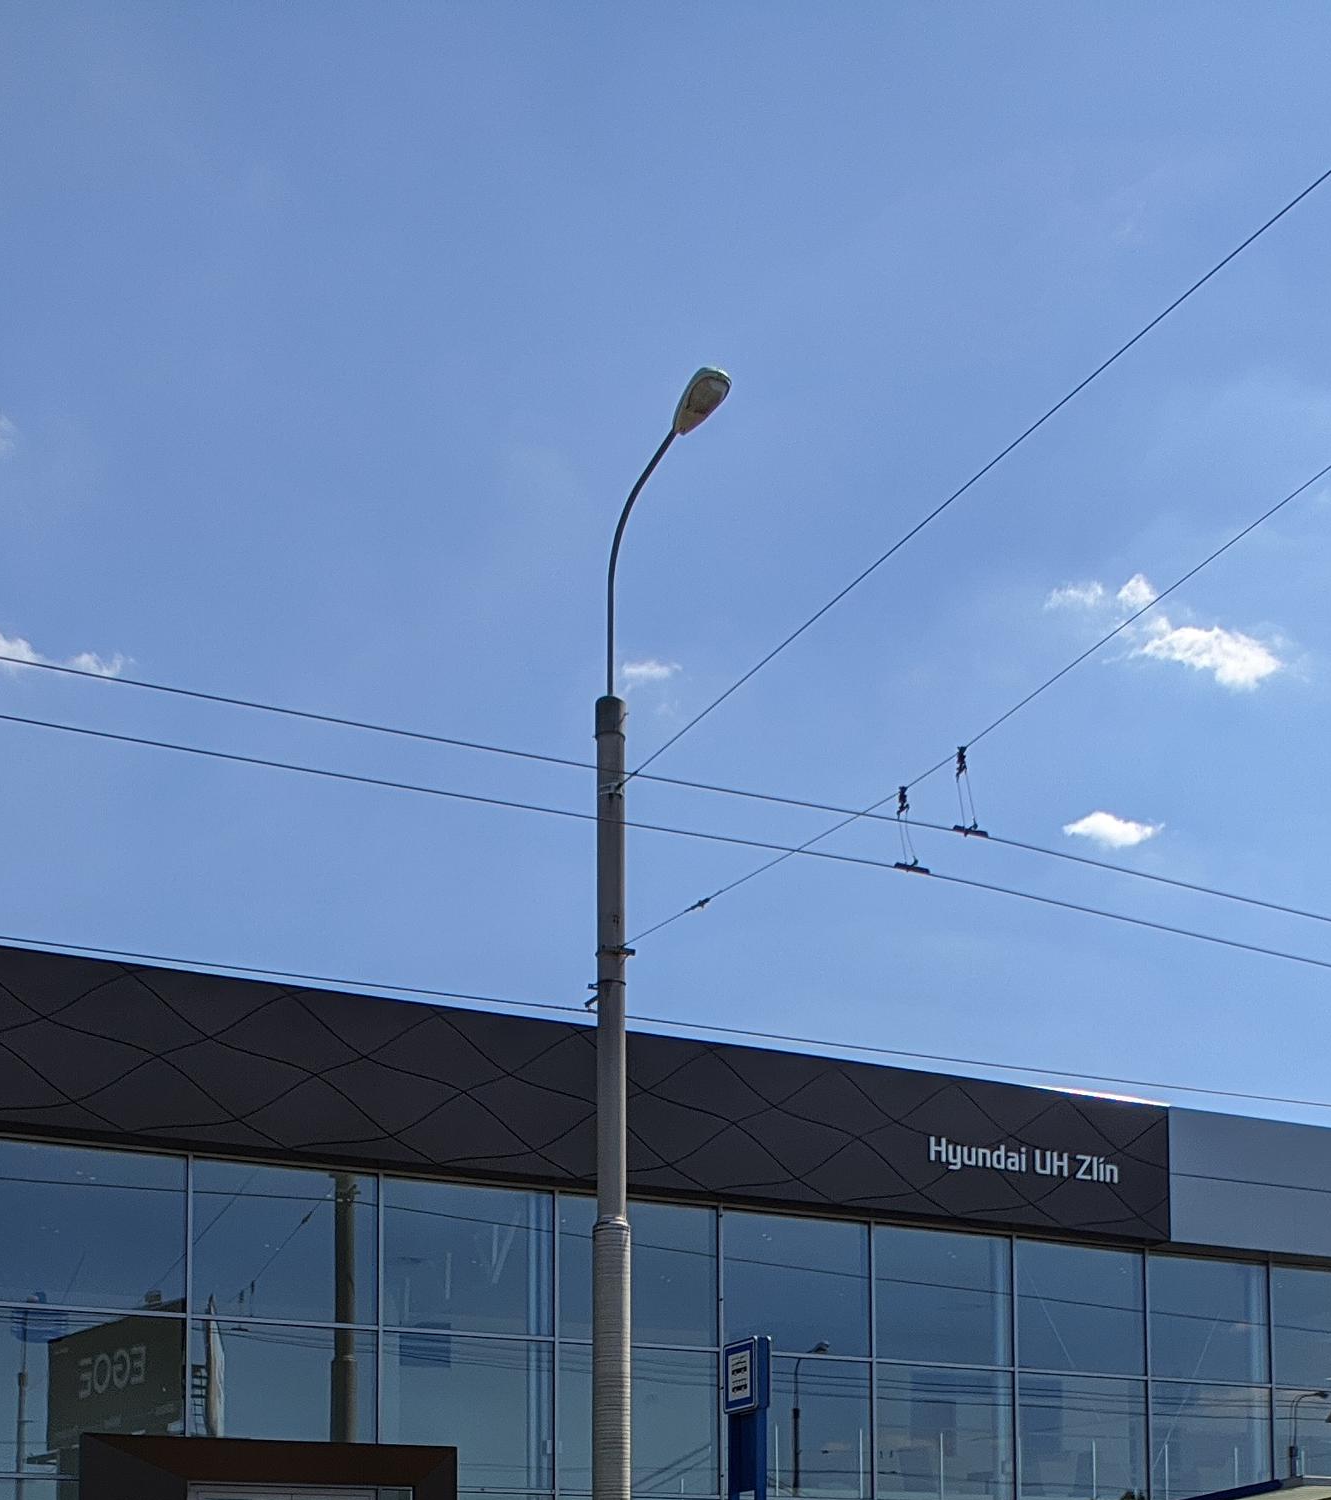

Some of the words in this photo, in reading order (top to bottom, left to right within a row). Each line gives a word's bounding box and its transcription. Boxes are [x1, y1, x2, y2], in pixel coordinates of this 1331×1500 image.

[928, 1136, 1027, 1172] Hyundai
[1034, 1149, 1069, 1177] UH
[1075, 1154, 1119, 1184] Zlín
